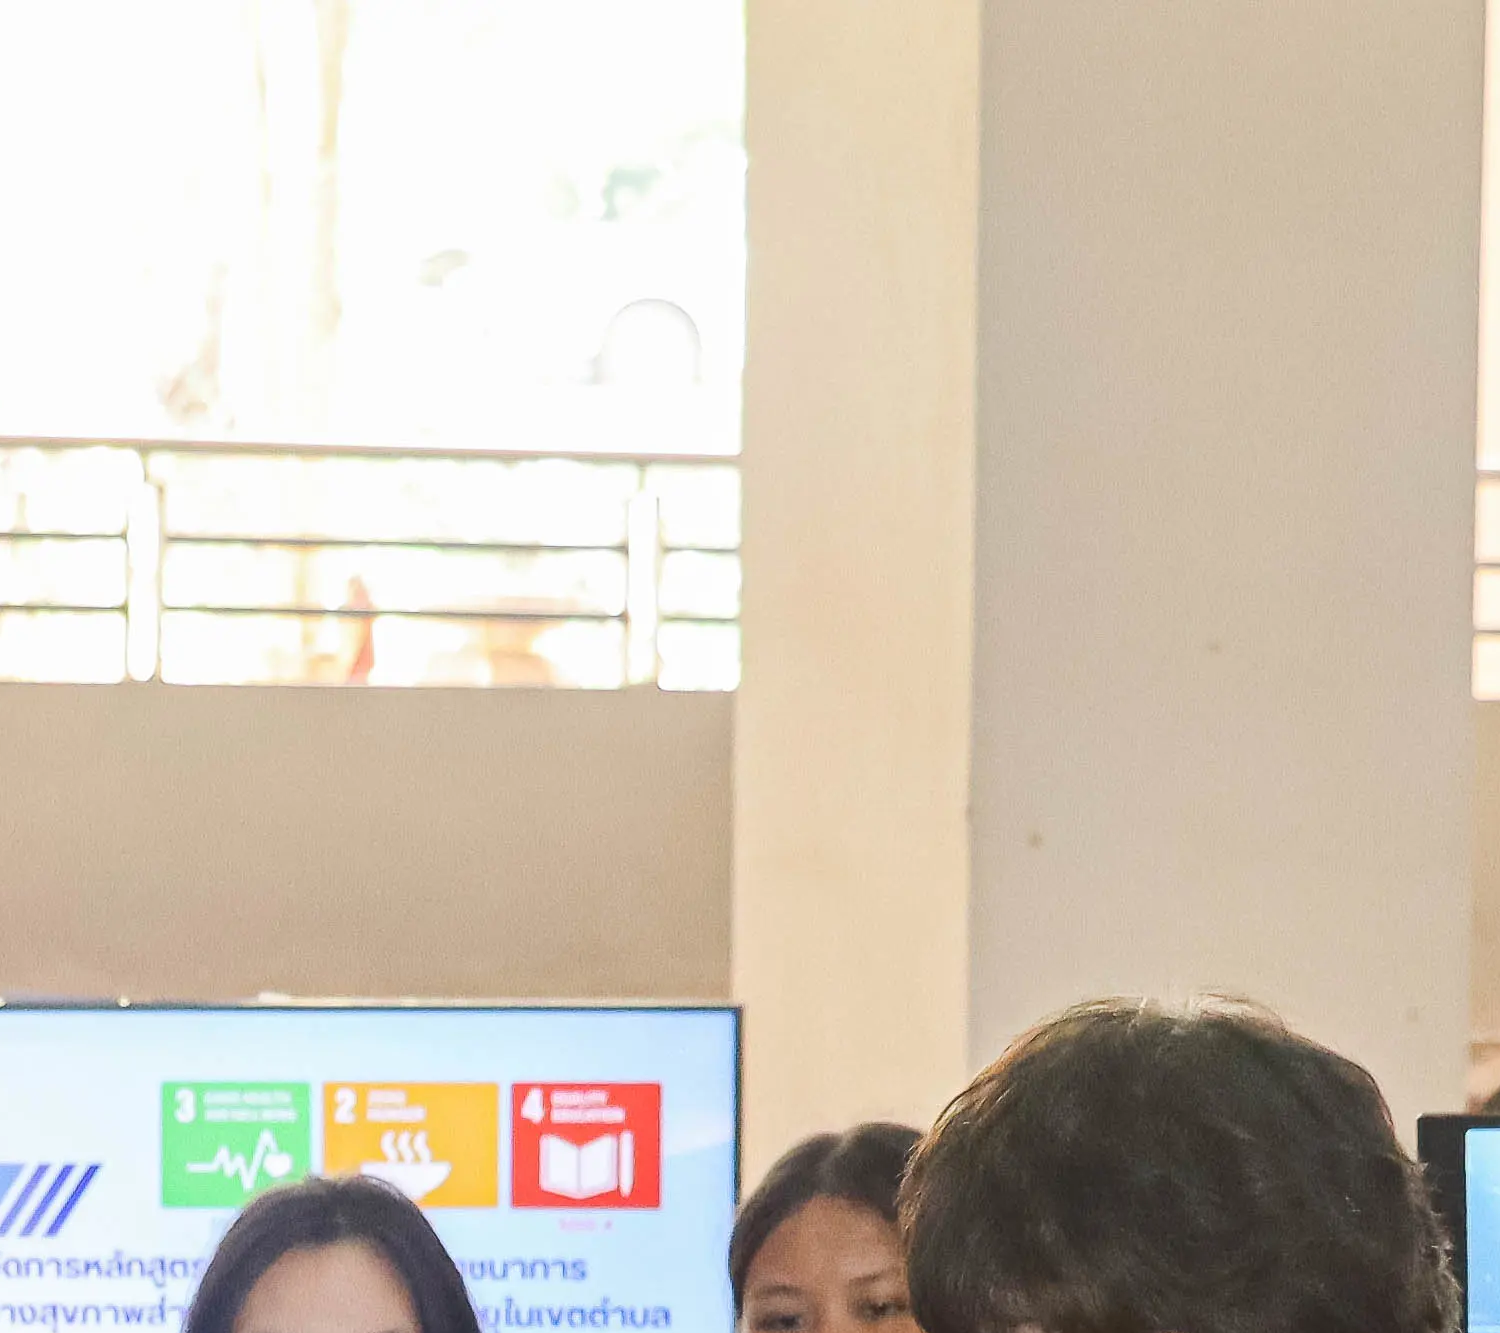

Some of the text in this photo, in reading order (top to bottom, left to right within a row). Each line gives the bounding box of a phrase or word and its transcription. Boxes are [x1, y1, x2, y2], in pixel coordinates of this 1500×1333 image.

[175, 1087, 197, 1123] 3
[334, 1087, 358, 1124] 2
[521, 1087, 545, 1124] 4
